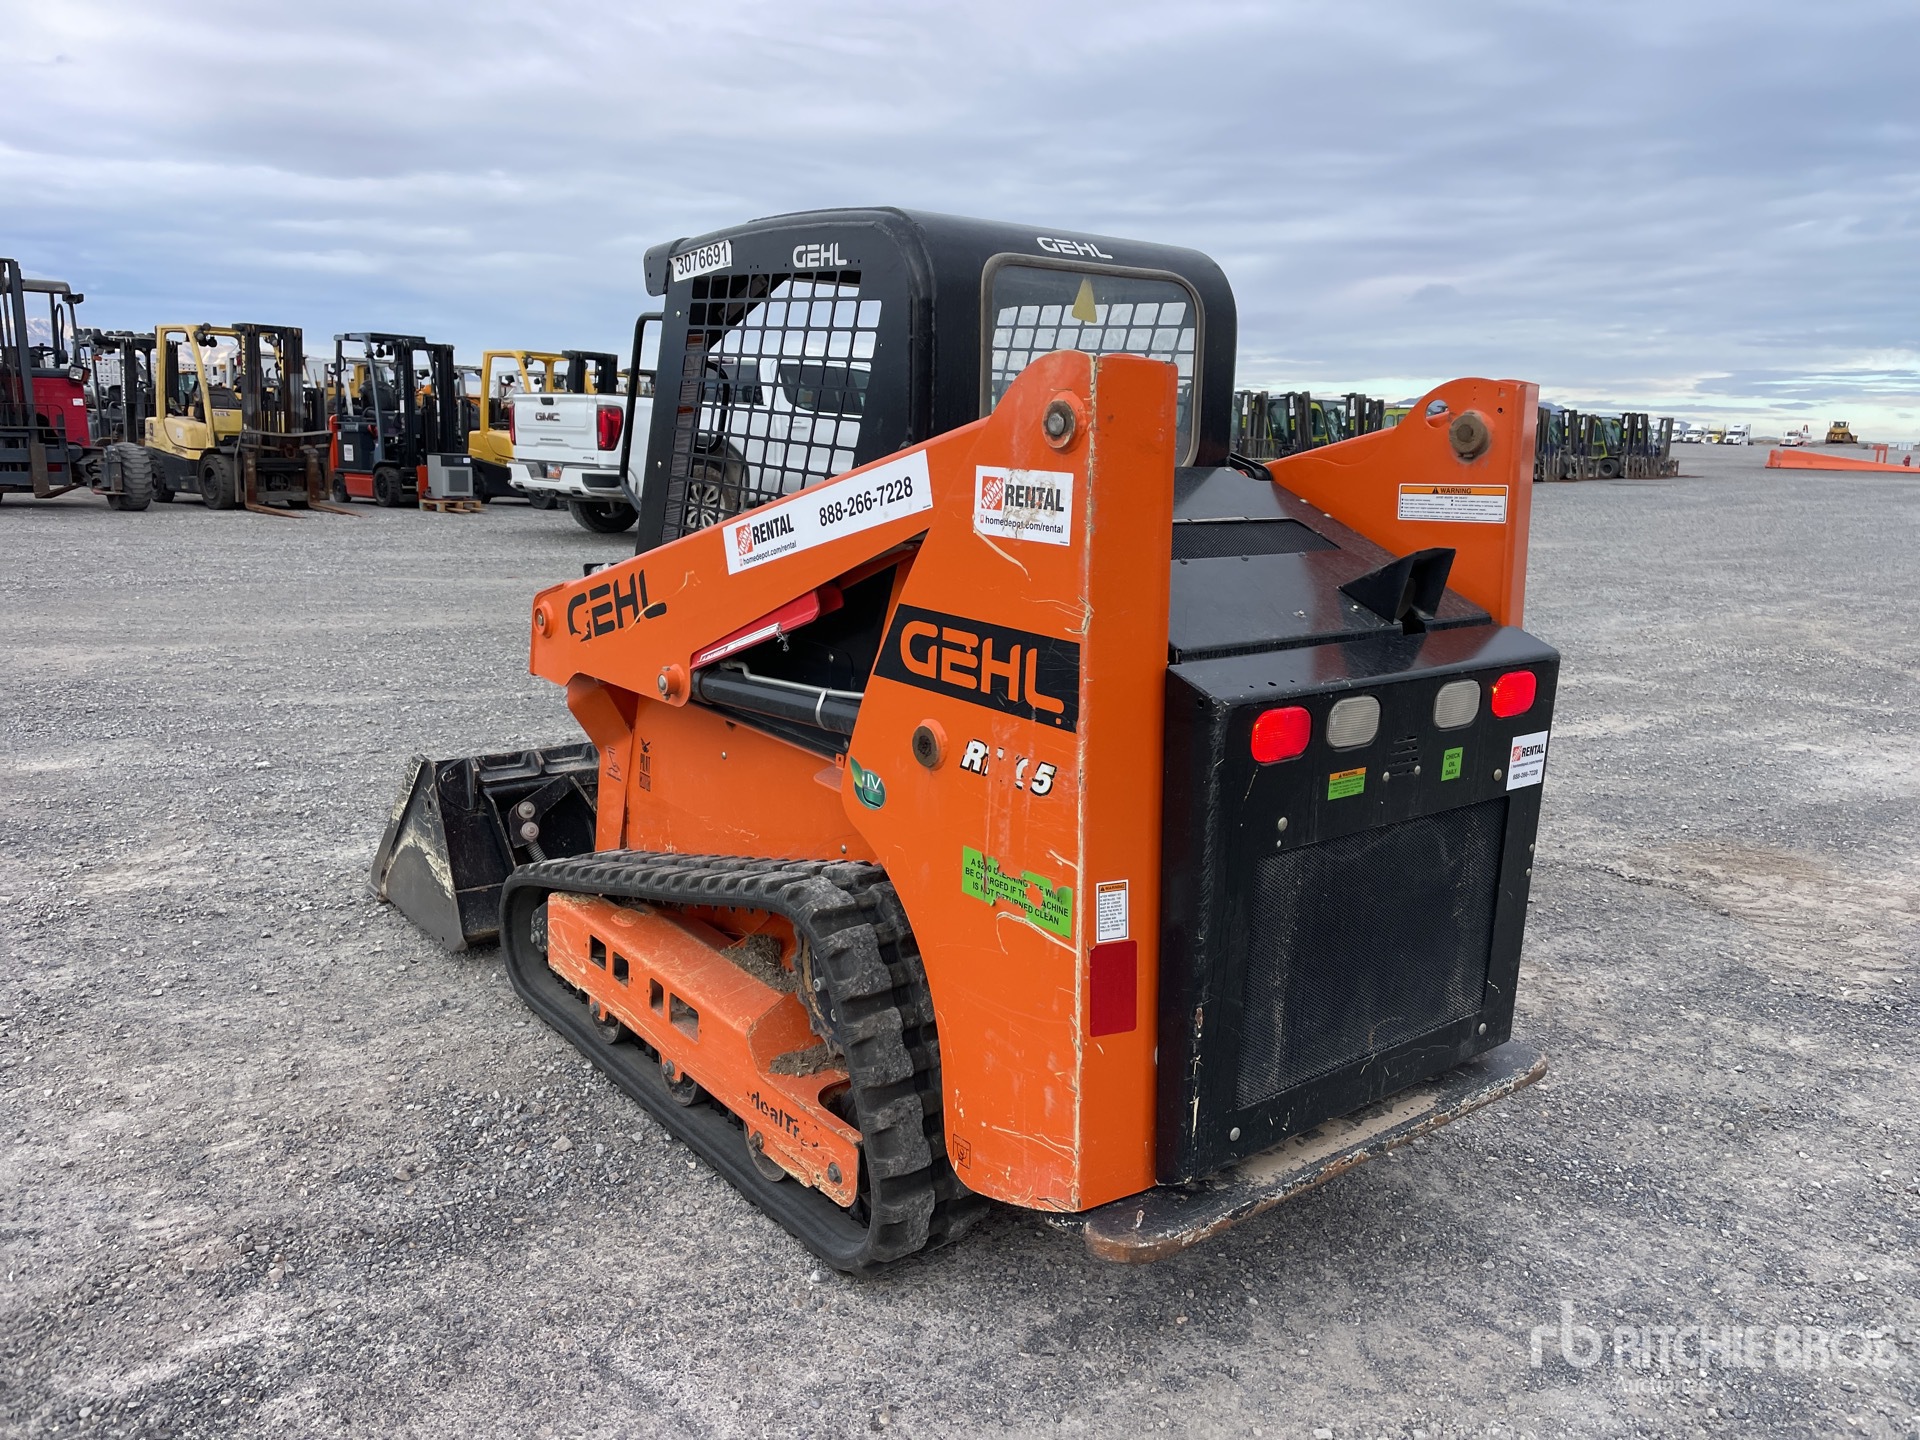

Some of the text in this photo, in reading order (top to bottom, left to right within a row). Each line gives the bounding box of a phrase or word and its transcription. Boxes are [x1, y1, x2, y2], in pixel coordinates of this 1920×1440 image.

[676, 241, 728, 275] 3076691
[792, 242, 848, 268] GEHL
[1036, 236, 1113, 259] GEHL
[535, 412, 561, 422] GMC
[819, 476, 913, 527] 888-266-7228
[1005, 484, 1065, 512] RENTAL
[1440, 487, 1472, 495] WARNING
[752, 513, 795, 546] RENTAL
[567, 569, 668, 642] GEHL
[900, 620, 1065, 714] GEHL
[1521, 744, 1545, 758] RENTAL
[965, 867, 974, 877] BE
[1010, 885, 1017, 895] IF
[1040, 899, 1069, 918] ACHINE
[973, 881, 979, 891] IS
[1034, 908, 1060, 926] CLEAN
